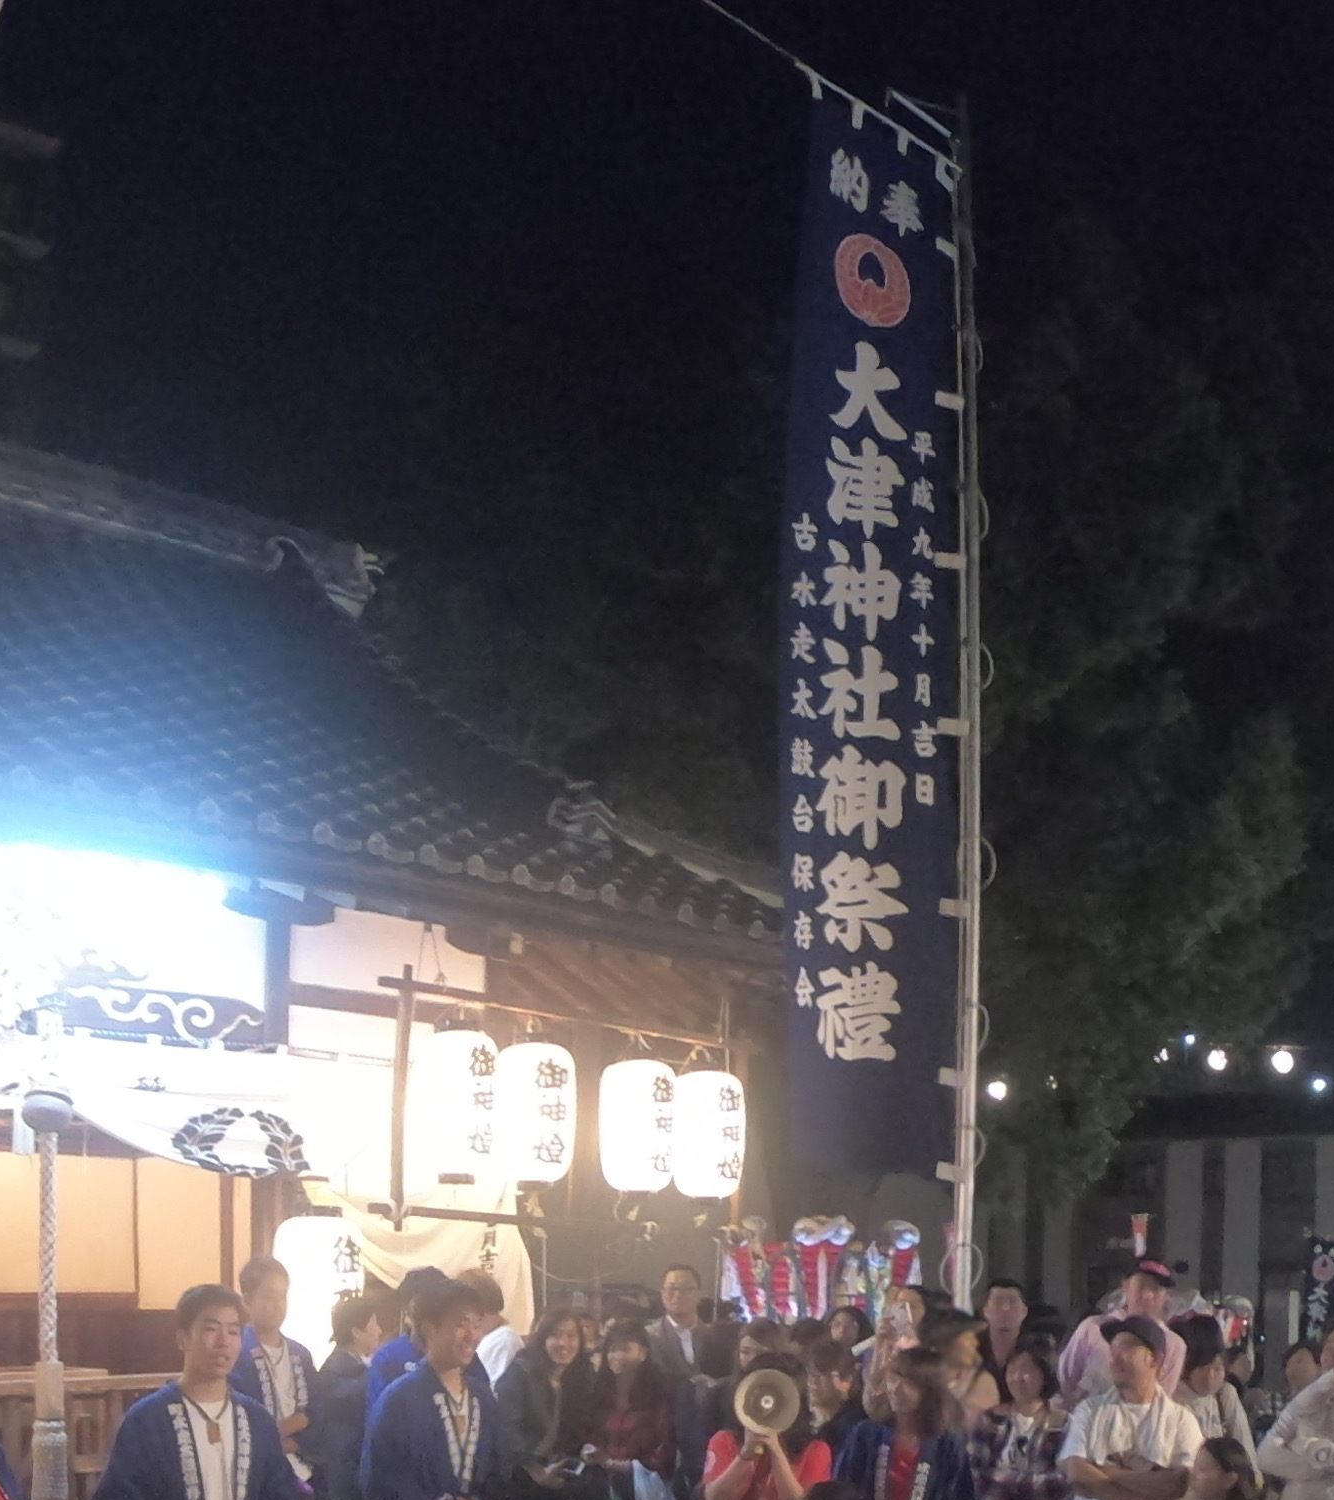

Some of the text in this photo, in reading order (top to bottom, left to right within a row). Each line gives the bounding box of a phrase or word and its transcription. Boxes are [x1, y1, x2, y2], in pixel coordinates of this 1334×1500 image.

[789, 513, 818, 1009] 古水走太鼓台保存会
[816, 341, 909, 1062] 大津神社御祭禮
[909, 430, 938, 807] 平成九年十月吉日
